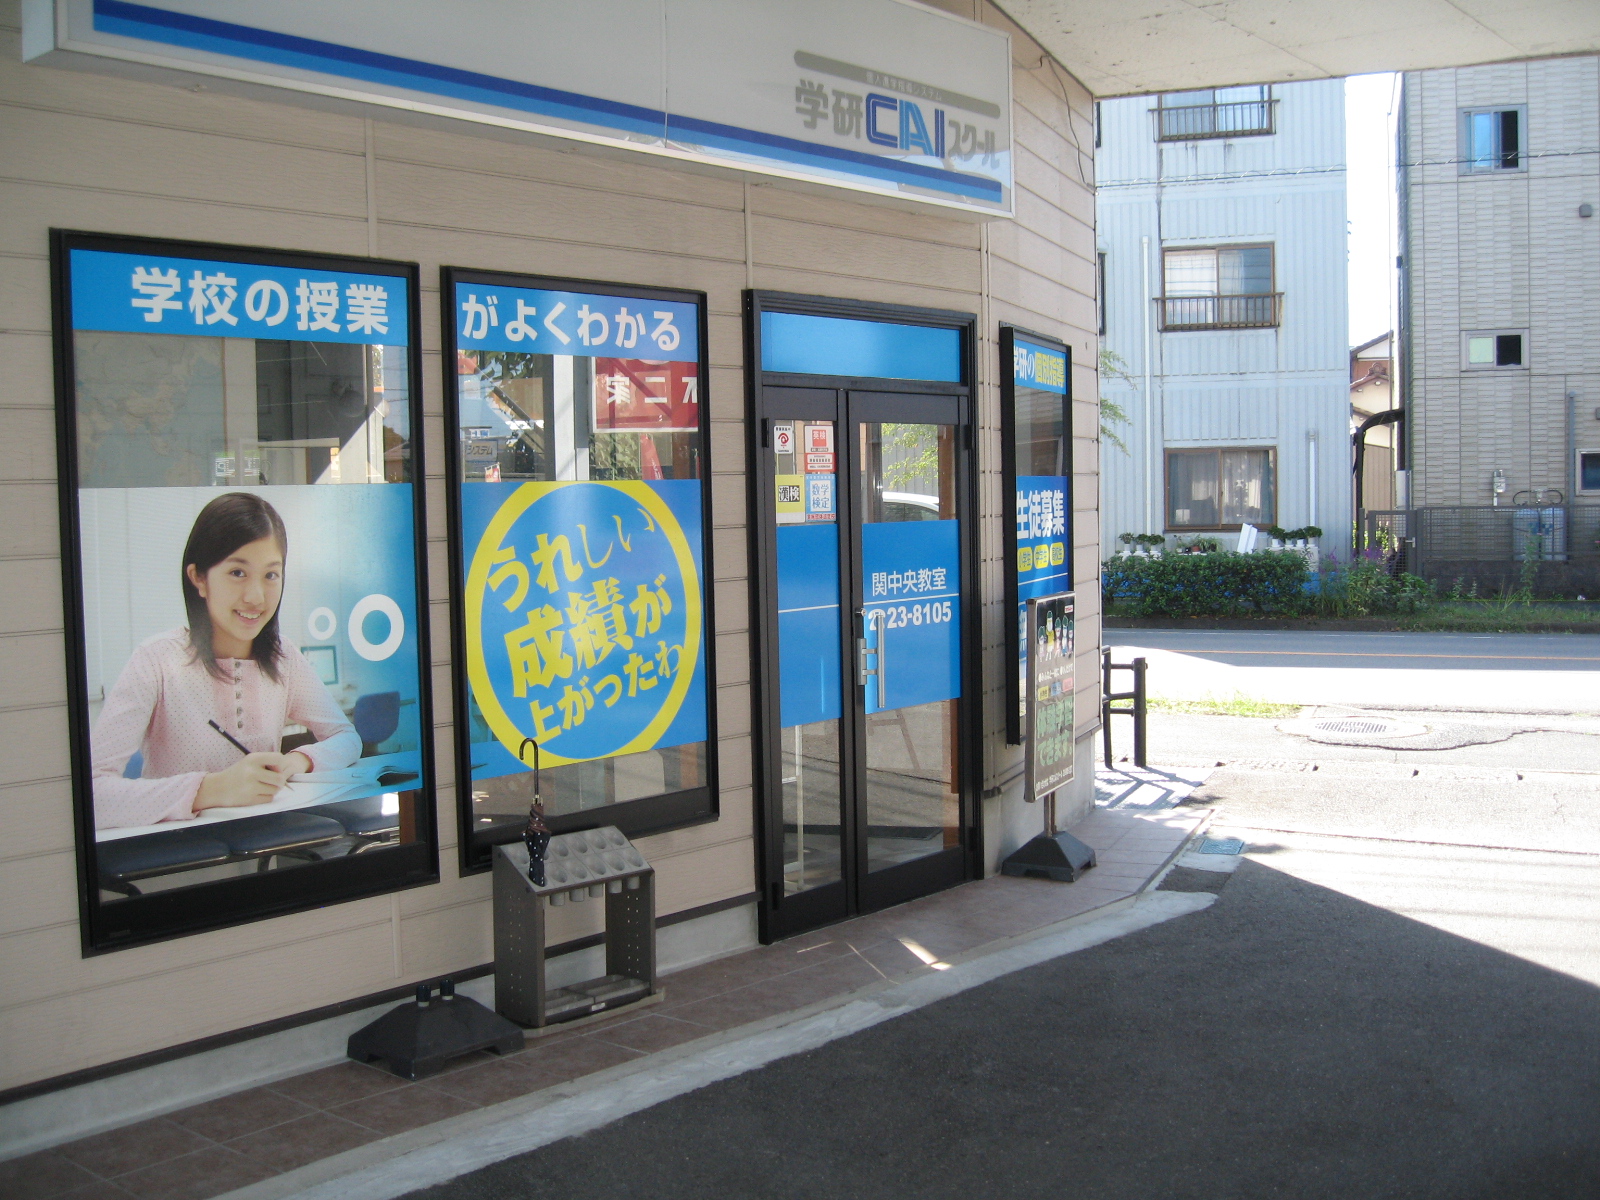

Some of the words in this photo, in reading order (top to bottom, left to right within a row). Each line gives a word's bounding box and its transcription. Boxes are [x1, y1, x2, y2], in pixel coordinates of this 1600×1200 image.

[131, 266, 389, 335] 学校の授業
[462, 294, 681, 352] がよくわかる
[778, 485, 800, 502] 漢検
[812, 483, 829, 496] 数学
[812, 497, 829, 509] 検定
[1016, 489, 1065, 539] 生徒募集
[487, 508, 655, 613] うれしい
[872, 567, 947, 596] 関中央教室
[887, 601, 952, 629] 23-8105
[504, 574, 673, 698] 成績が
